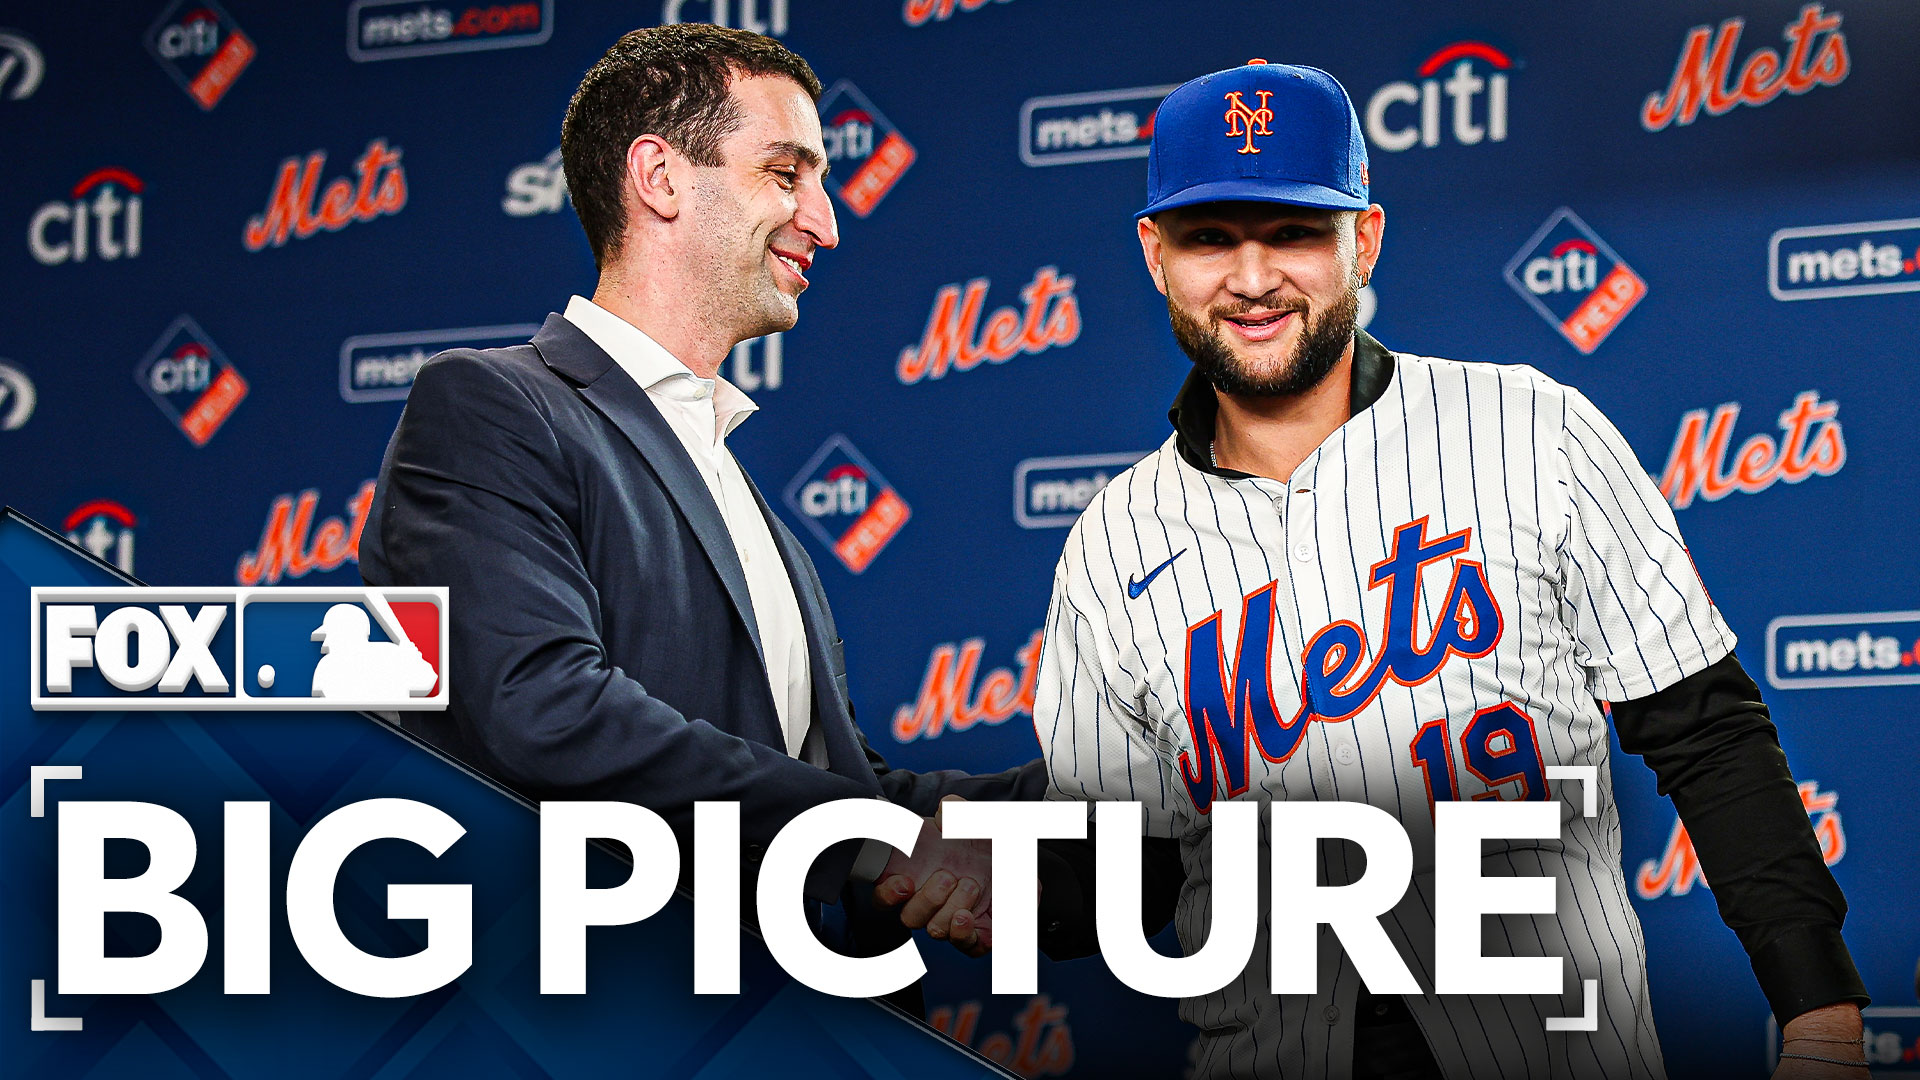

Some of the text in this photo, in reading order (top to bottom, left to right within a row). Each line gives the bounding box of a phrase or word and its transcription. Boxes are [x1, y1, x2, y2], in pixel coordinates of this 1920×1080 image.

[362, 2, 541, 45] mets.com
[1641, 2, 1851, 132] Mets
[1366, 60, 1509, 152] citi
[28, 184, 144, 266] citi
[242, 138, 408, 252] Mets
[896, 265, 1082, 386] Mets
[1524, 248, 1598, 295] citi
[801, 474, 868, 517] citi
[1651, 389, 1847, 511] Mets
[1177, 514, 1505, 815] Mets
[1408, 701, 1552, 828] 19
